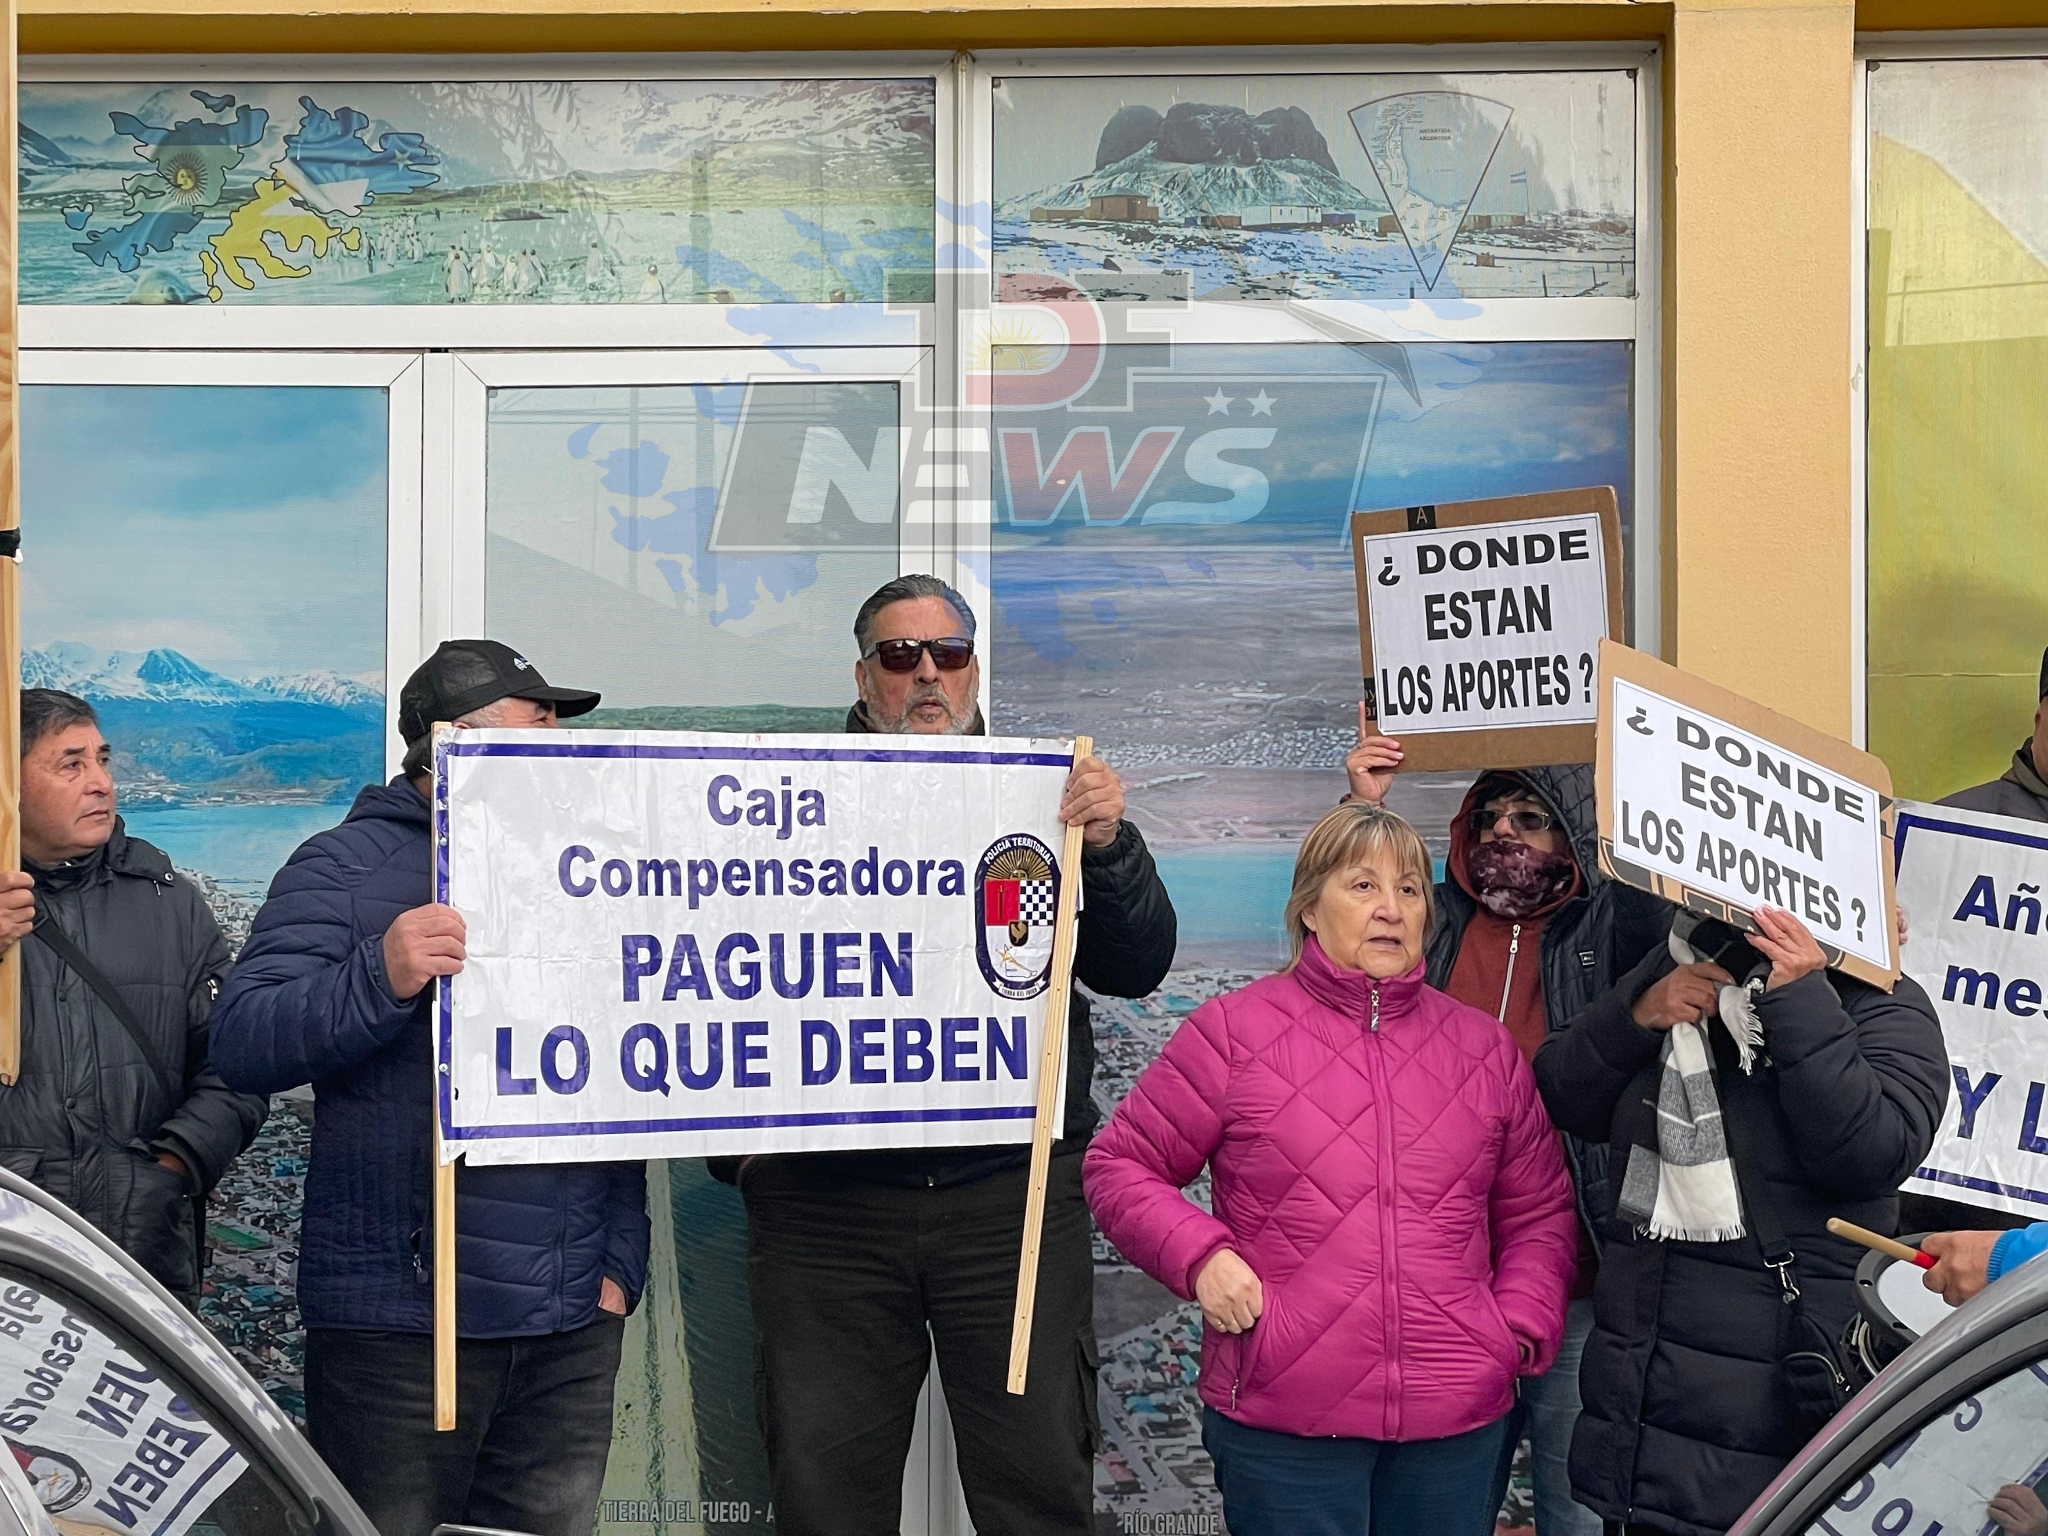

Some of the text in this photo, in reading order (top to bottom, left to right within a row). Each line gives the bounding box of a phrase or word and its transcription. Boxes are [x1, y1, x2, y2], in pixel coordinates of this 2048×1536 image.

[1417, 529, 1589, 575] DONDE
[1424, 584, 1553, 641] ESTAN
[1381, 652, 1594, 717] LOS APORTES ?
[1676, 716, 1865, 823] DONDE
[707, 775, 827, 840] Caja
[1681, 761, 1823, 862] ESTAN
[558, 846, 966, 910] Compensadora
[984, 836, 1054, 866] POLICIA TERRITORIAL
[1622, 800, 1867, 943] LOS APORTES ?
[1952, 874, 2048, 936] Añ
[621, 932, 914, 1003] PAGUEN
[495, 1015, 1028, 1098] LO QUE DEBEN
[1950, 1064, 2003, 1140] Y
[602, 1501, 661, 1523] TIERRA
[664, 1501, 696, 1523] DEL
[701, 1501, 750, 1523] FUEGO
[1123, 1508, 1220, 1536] RÍO GRANDE
